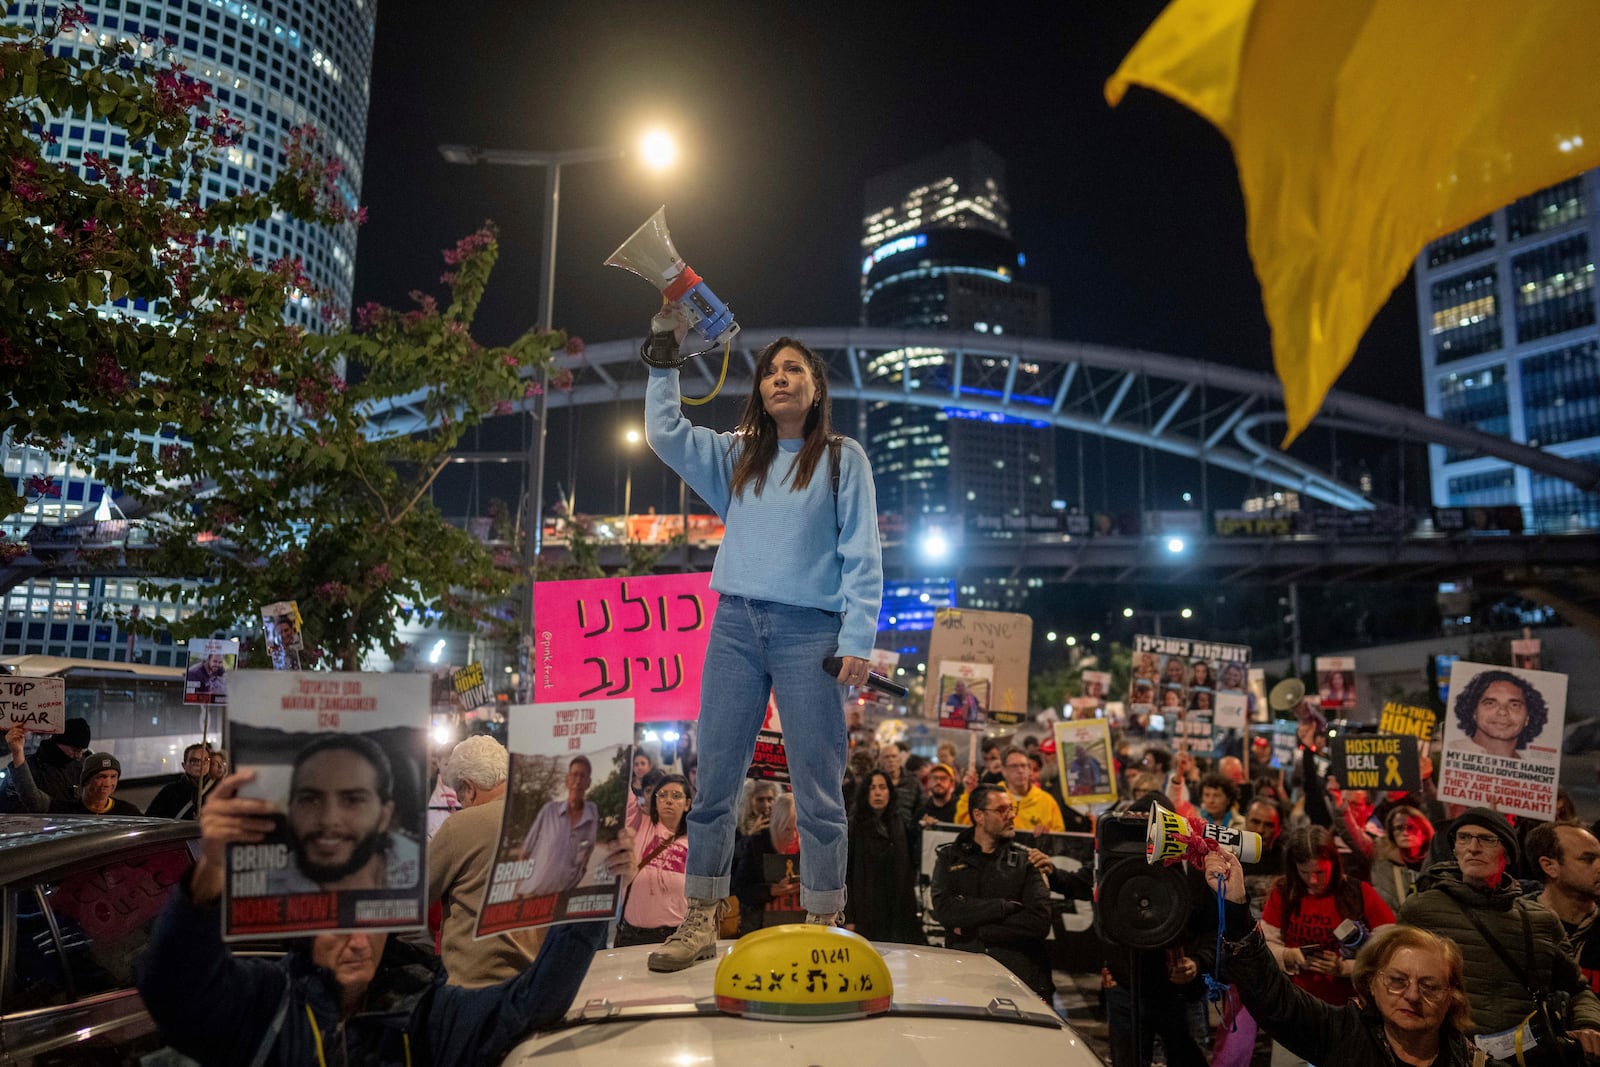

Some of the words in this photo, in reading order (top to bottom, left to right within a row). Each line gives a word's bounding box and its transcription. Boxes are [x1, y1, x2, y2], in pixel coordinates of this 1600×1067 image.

[577, 582, 705, 638] כולנו
[540, 630, 555, 689] @pink.front
[455, 671, 484, 694] HOME
[579, 653, 684, 698] עינב
[11, 712, 51, 724] WAR
[1379, 712, 1434, 742] HOME
[1345, 739, 1401, 754] HOSTAGE
[1346, 755, 1379, 770] DEAL
[1447, 751, 1461, 761] MY
[1463, 754, 1483, 764] LIFE
[1500, 759, 1519, 770] THE
[1520, 763, 1556, 776] HANDS
[1462, 763, 1495, 775] ISRAELI
[1496, 768, 1555, 785] GOVERNMENT
[1347, 771, 1379, 788] NOW
[1444, 769, 1452, 777] IF
[1455, 770, 1475, 781] THEY
[1476, 774, 1499, 785] DON'T
[1501, 778, 1521, 788] SIGN
[1522, 781, 1530, 790] A
[1530, 783, 1553, 794] DEAL
[1445, 777, 1471, 789] THEY
[1472, 781, 1493, 793] ARE
[1494, 785, 1535, 801] SIGNING
[1536, 793, 1553, 803] MY
[1443, 786, 1482, 803] DEATH
[232, 844, 288, 871] BRING
[650, 858, 674, 870] DEAL
[494, 858, 536, 883] BRING
[231, 870, 267, 898] HIM
[487, 881, 516, 905] HIM
[811, 948, 850, 964] 01241
